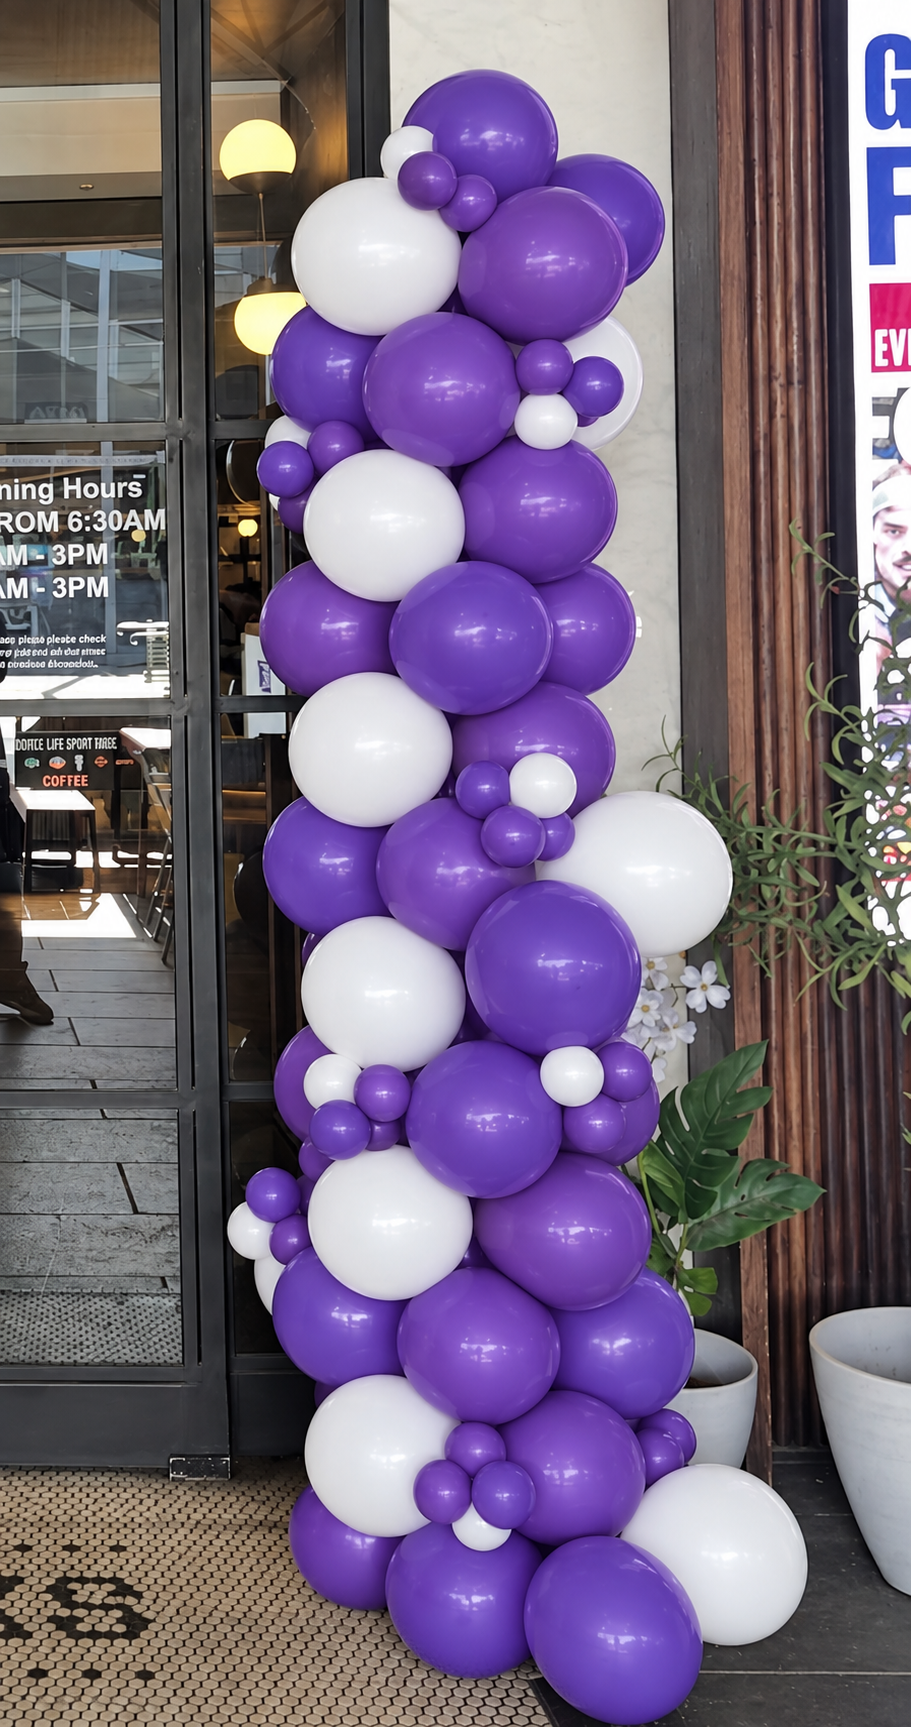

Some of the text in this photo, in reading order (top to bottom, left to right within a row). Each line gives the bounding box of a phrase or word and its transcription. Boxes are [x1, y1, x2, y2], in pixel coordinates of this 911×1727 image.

[874, 328, 911, 367] EV
[63, 477, 143, 499] Hours
[67, 508, 166, 532] 6:30AM
[51, 543, 108, 566] 3PM
[52, 576, 109, 599] 3PM
[78, 634, 107, 644] check
[66, 737, 93, 750] SPORT
[42, 774, 89, 787] COFFEE
